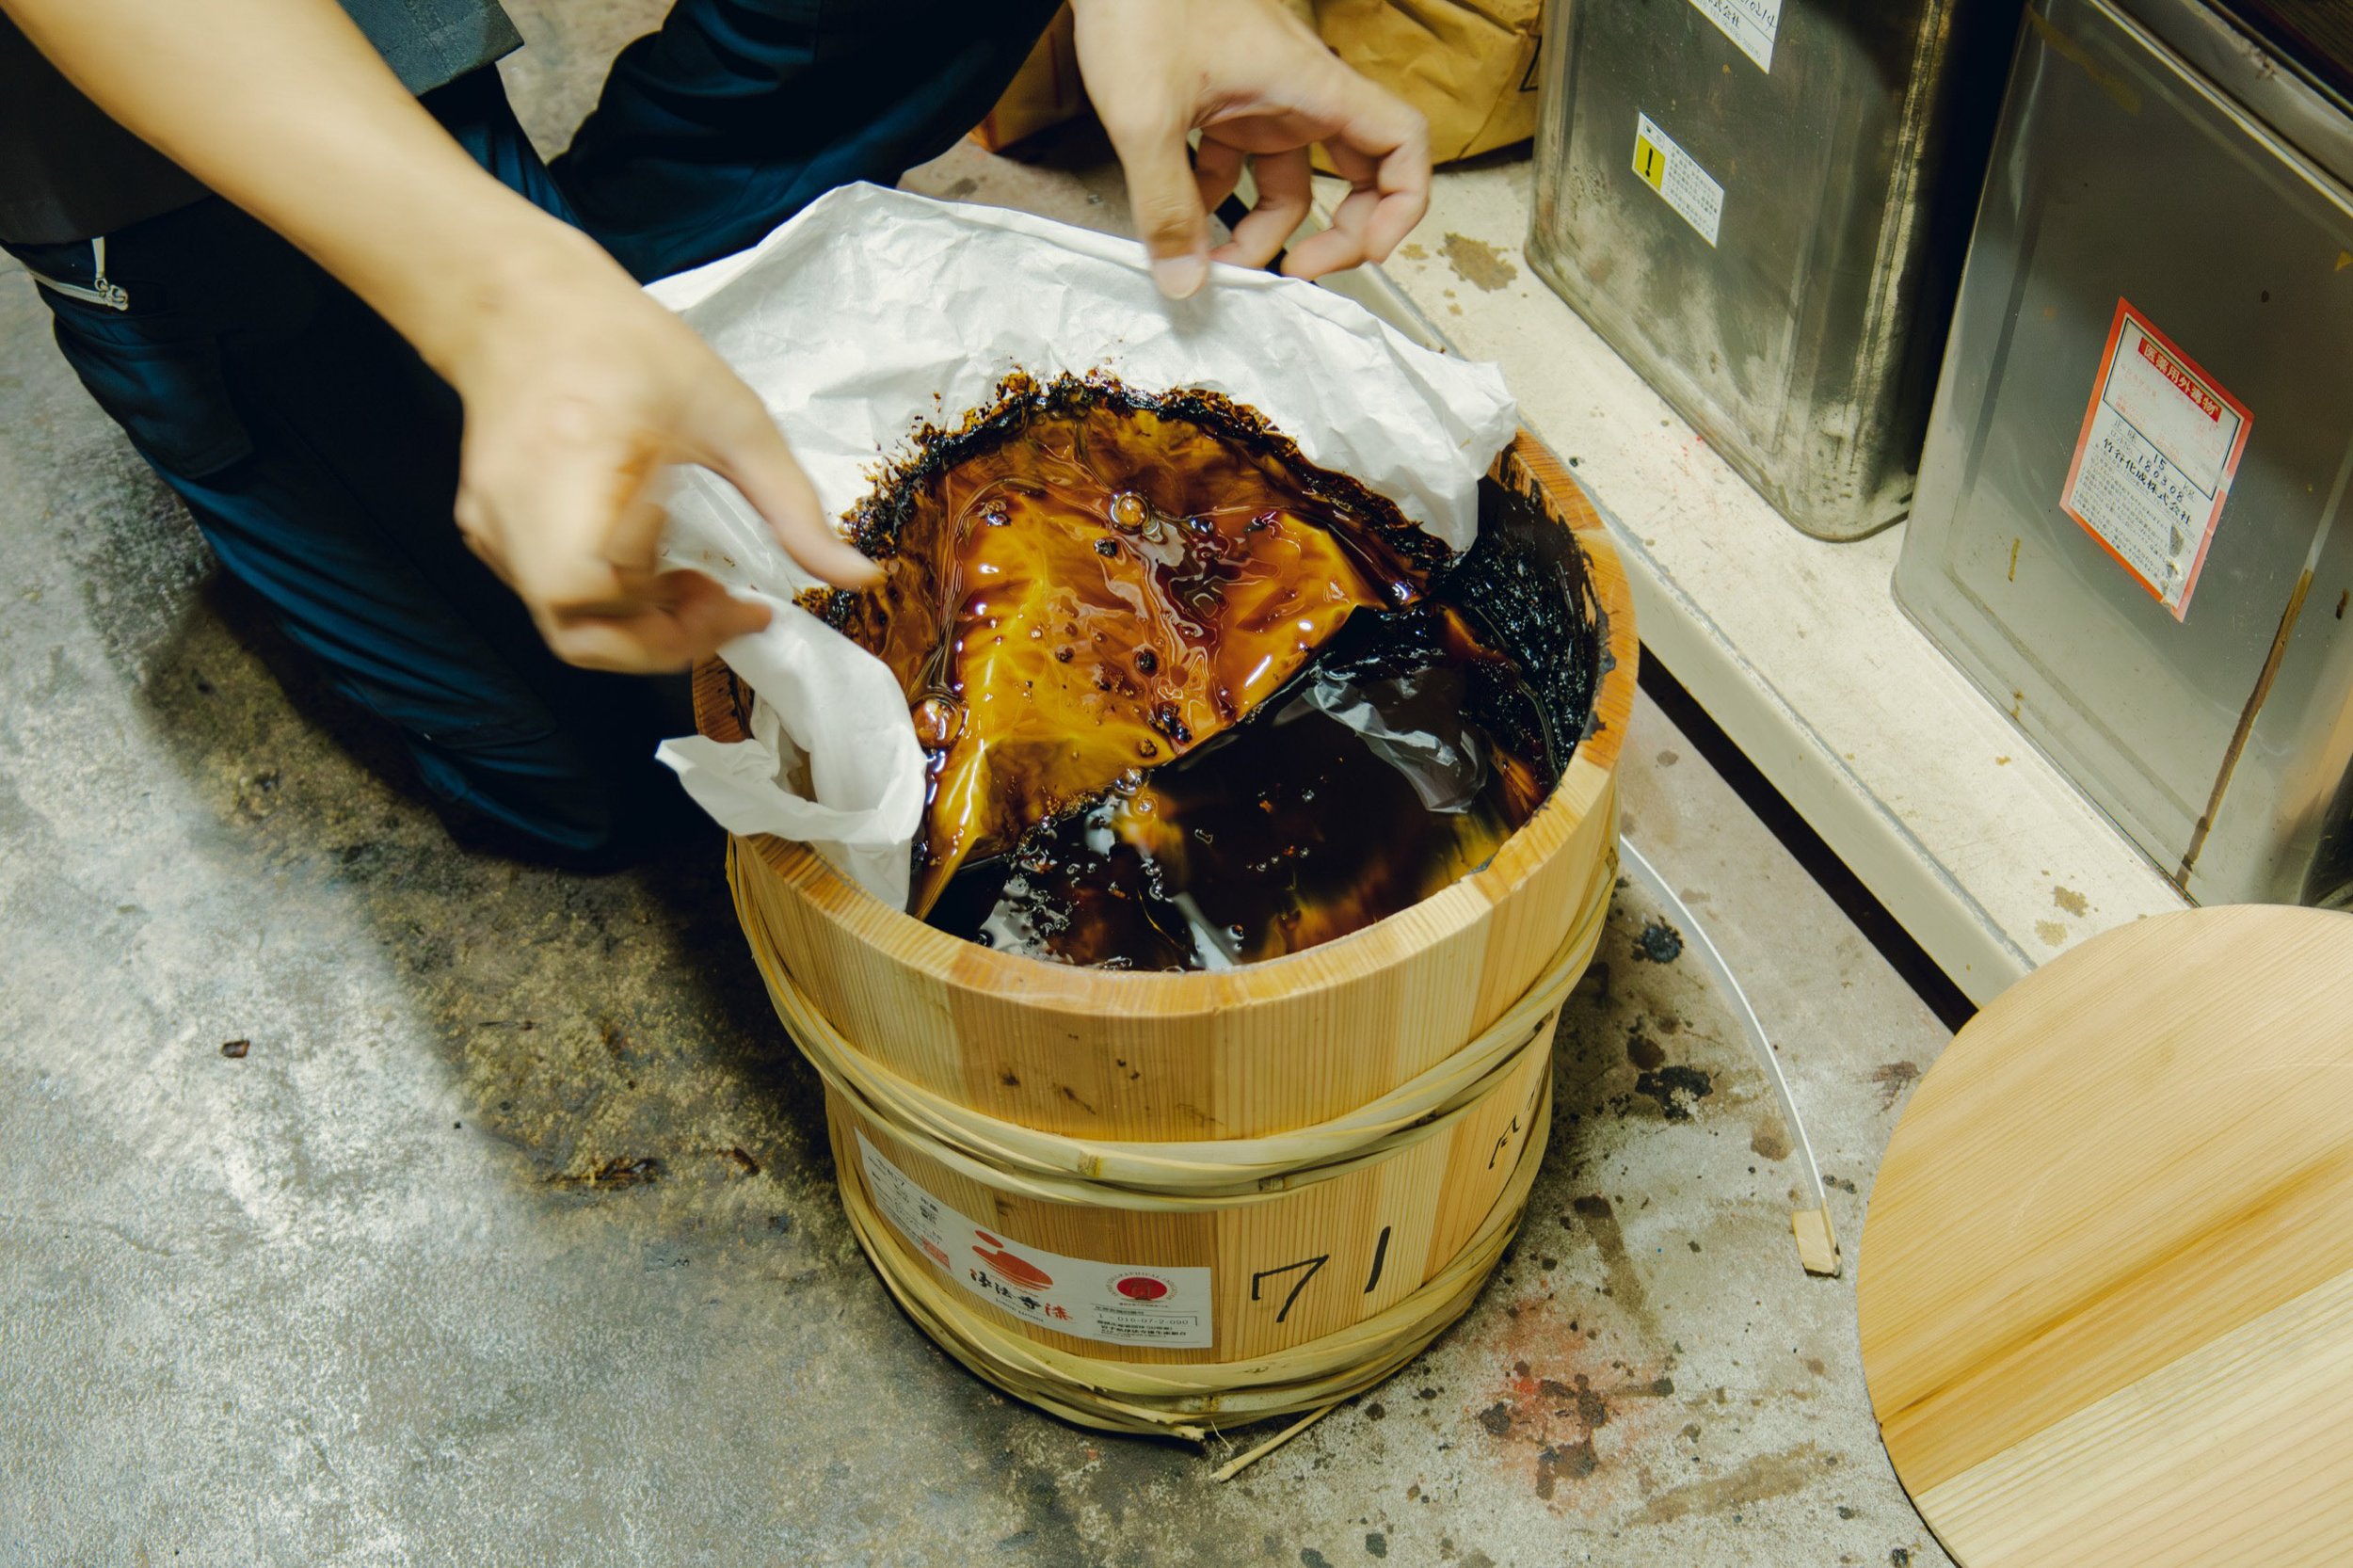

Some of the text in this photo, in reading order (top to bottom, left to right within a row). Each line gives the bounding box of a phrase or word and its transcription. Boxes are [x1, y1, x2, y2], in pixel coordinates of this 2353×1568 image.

[2143, 344, 2218, 416] 医薬用外毒物
[2103, 438, 2192, 525] 竹谷化成株式会社
[2137, 455, 2185, 504] 180308
[2153, 453, 2168, 472] 15
